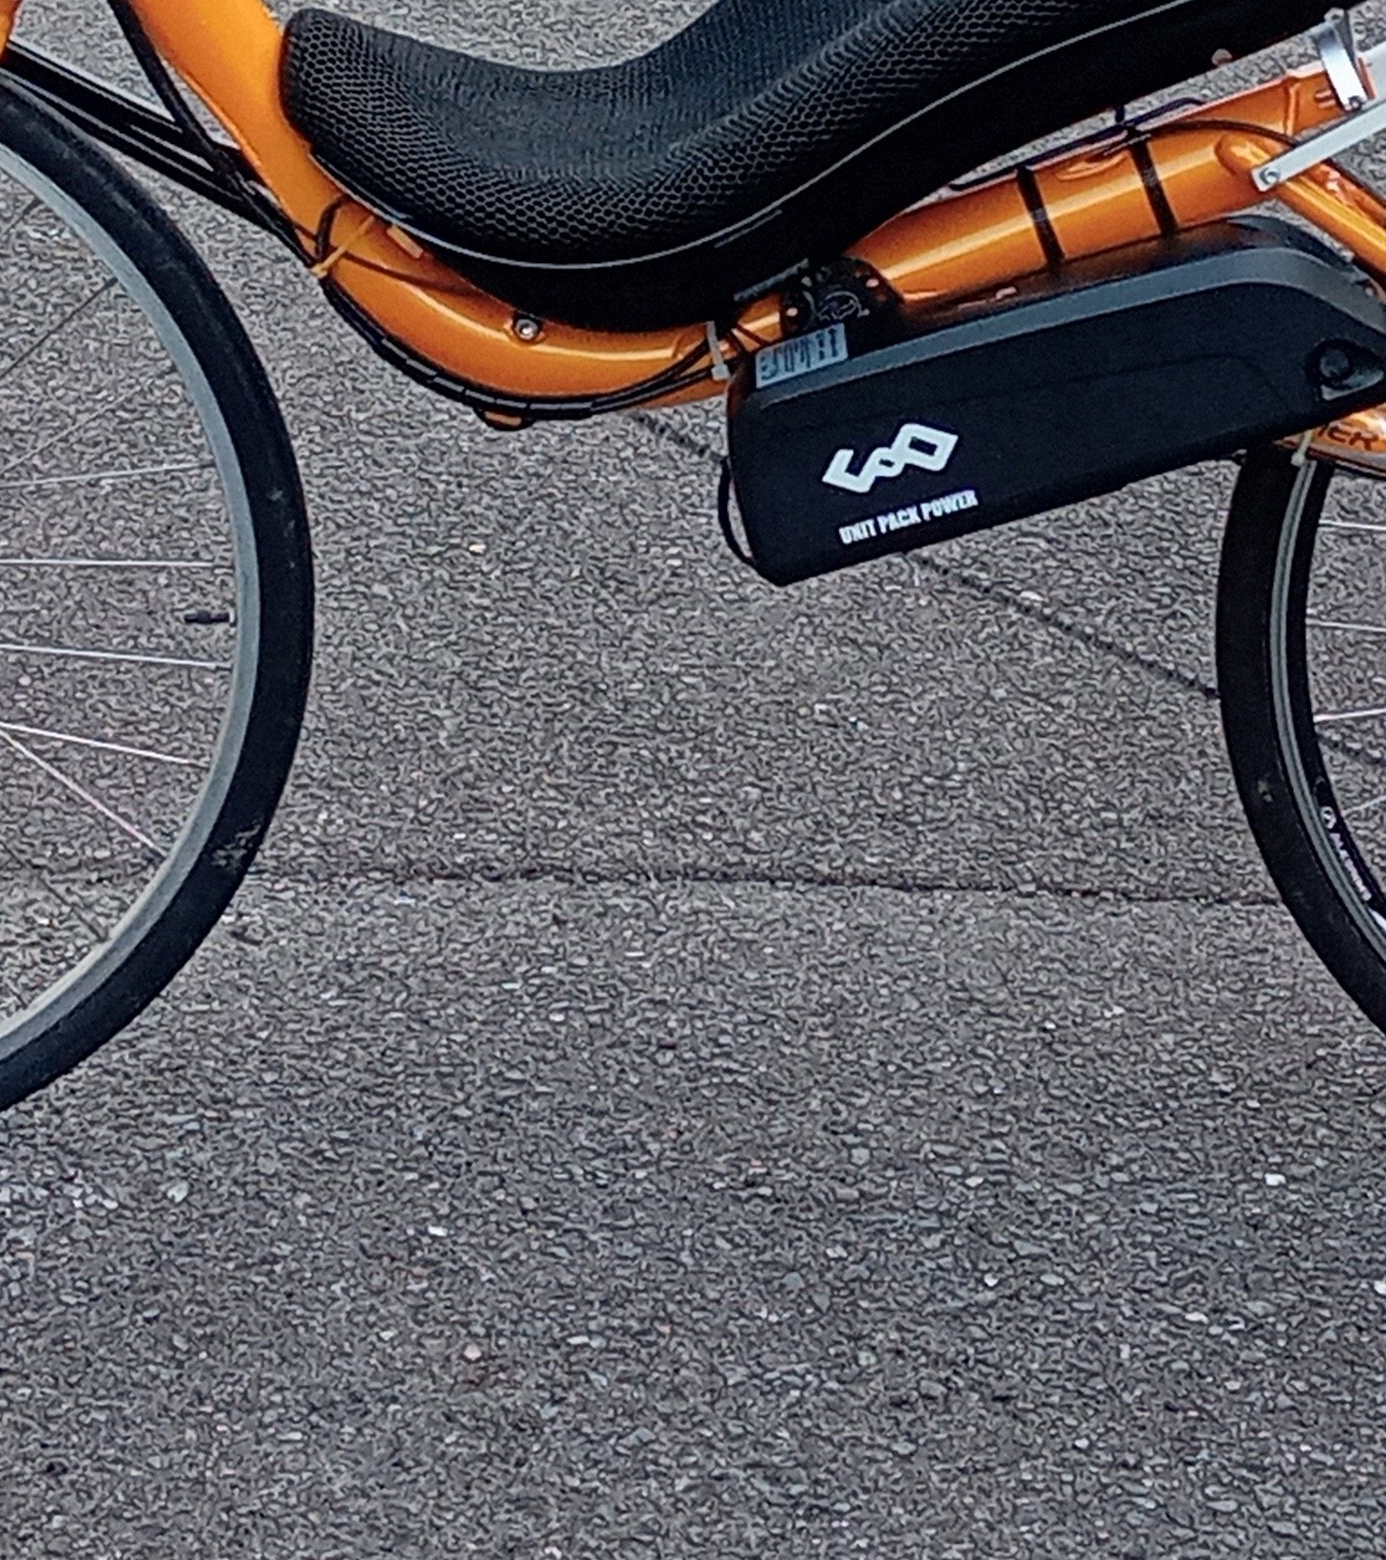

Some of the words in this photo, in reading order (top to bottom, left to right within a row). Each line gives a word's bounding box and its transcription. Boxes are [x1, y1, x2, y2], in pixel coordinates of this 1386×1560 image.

[838, 518, 877, 545] UNIT
[876, 505, 922, 534] PACK
[920, 489, 979, 522] POWER
